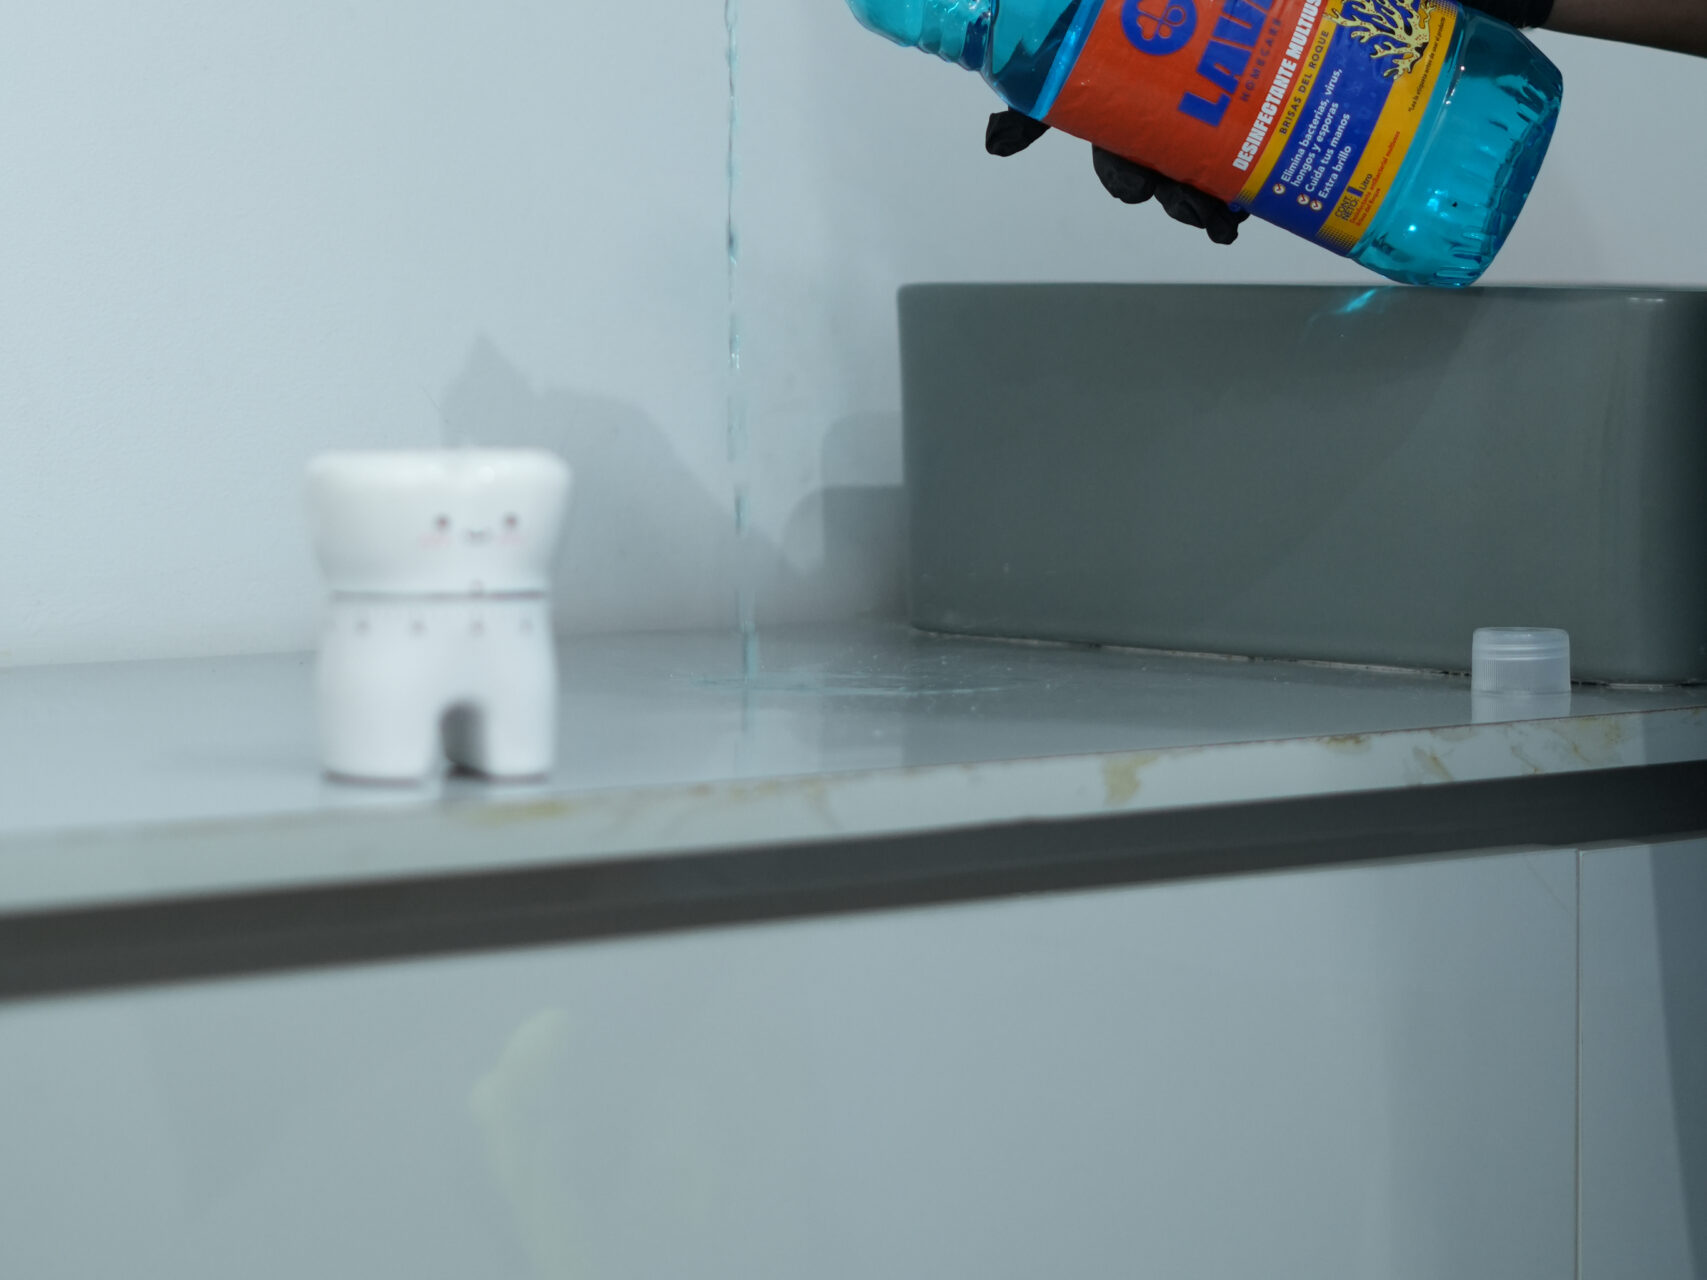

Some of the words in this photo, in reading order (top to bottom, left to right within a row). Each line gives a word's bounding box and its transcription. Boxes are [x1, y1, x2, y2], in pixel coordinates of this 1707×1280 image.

[1240, 18, 1281, 101] HOMECARE
[1279, 96, 1302, 135] BRISAS
[1299, 73, 1313, 93] DEL
[1311, 30, 1329, 68] ROQUE
[1232, 58, 1297, 171] DESINFECTANTE
[1281, 148, 1306, 182] Elimina
[1300, 98, 1330, 147] bacterias,
[1325, 68, 1343, 95] virus,
[1290, 152, 1316, 187] hongos
[1311, 143, 1321, 153] y
[1316, 101, 1339, 143] esporas
[1305, 166, 1325, 192] Cuida
[1320, 148, 1334, 165] tus
[1330, 113, 1350, 148] manos
[1318, 172, 1339, 199] Extra
[1332, 145, 1351, 172] brillo
[1359, 173, 1373, 190] Litro
